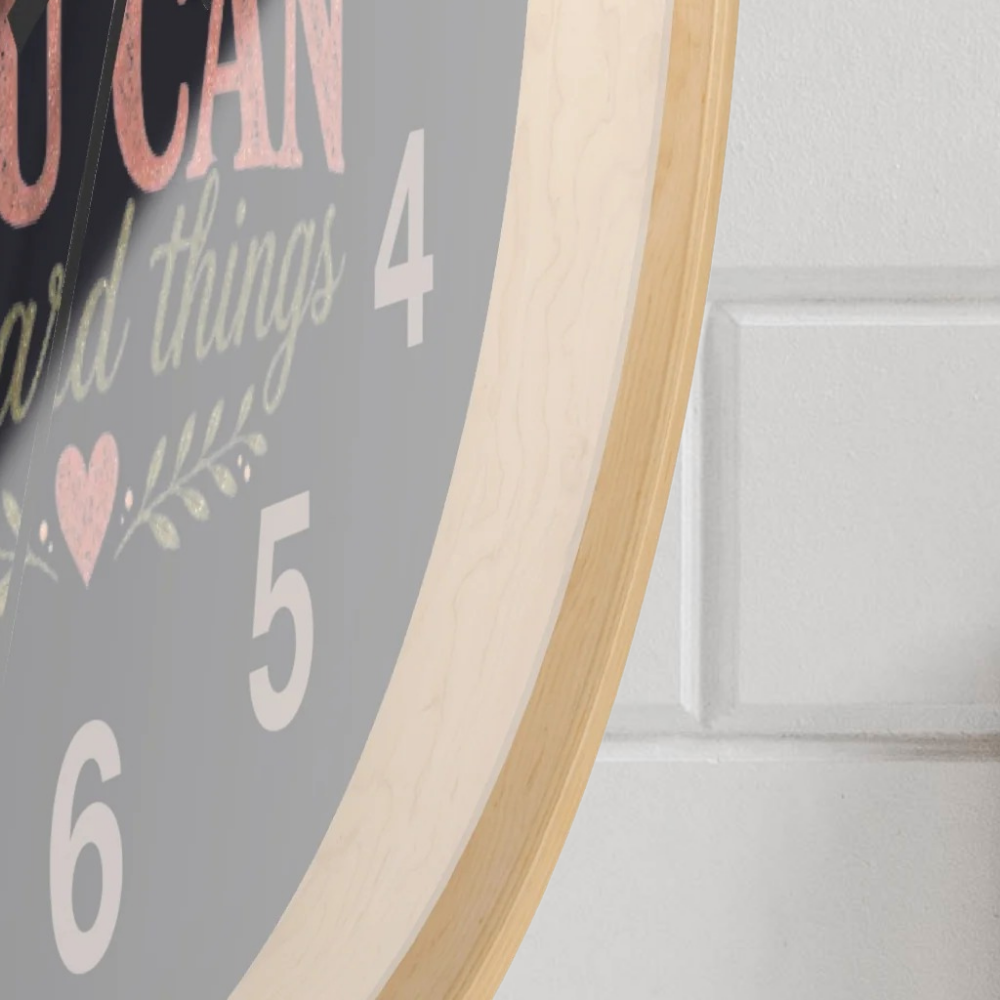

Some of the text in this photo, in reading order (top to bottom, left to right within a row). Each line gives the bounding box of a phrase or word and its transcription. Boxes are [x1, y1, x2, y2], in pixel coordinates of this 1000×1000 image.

[150, 168, 347, 415] things
[374, 128, 435, 348] 4
[248, 490, 314, 732] 5
[49, 719, 124, 975] 6
